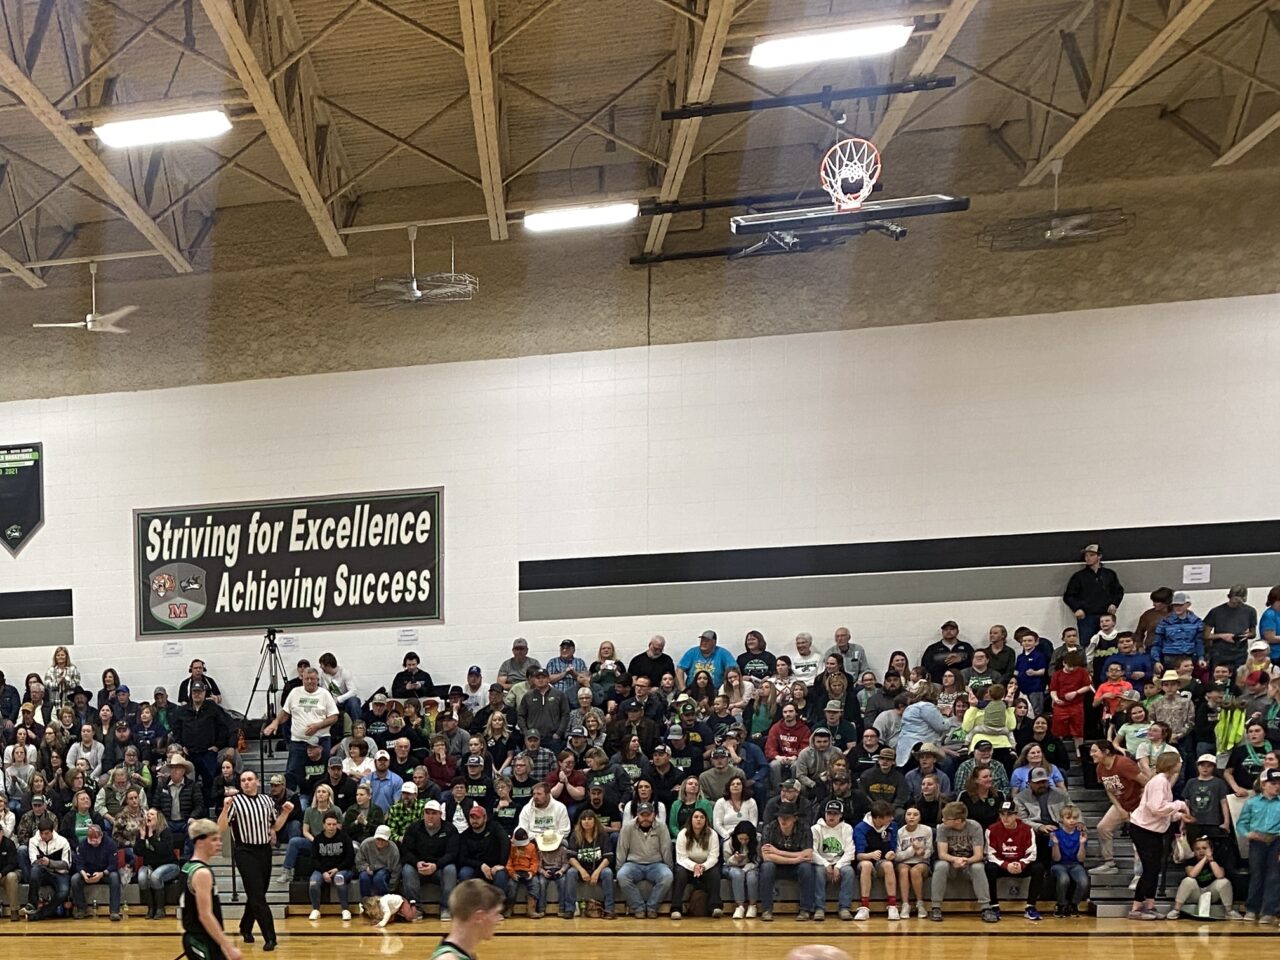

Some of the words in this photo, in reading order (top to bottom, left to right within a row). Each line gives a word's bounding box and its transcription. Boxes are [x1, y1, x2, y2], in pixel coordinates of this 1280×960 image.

[5, 467, 18, 475] 2021
[146, 515, 241, 567] Striving
[247, 511, 284, 555] for
[289, 504, 431, 552] Excellence
[215, 567, 327, 618] Achieving
[334, 563, 431, 608] Success
